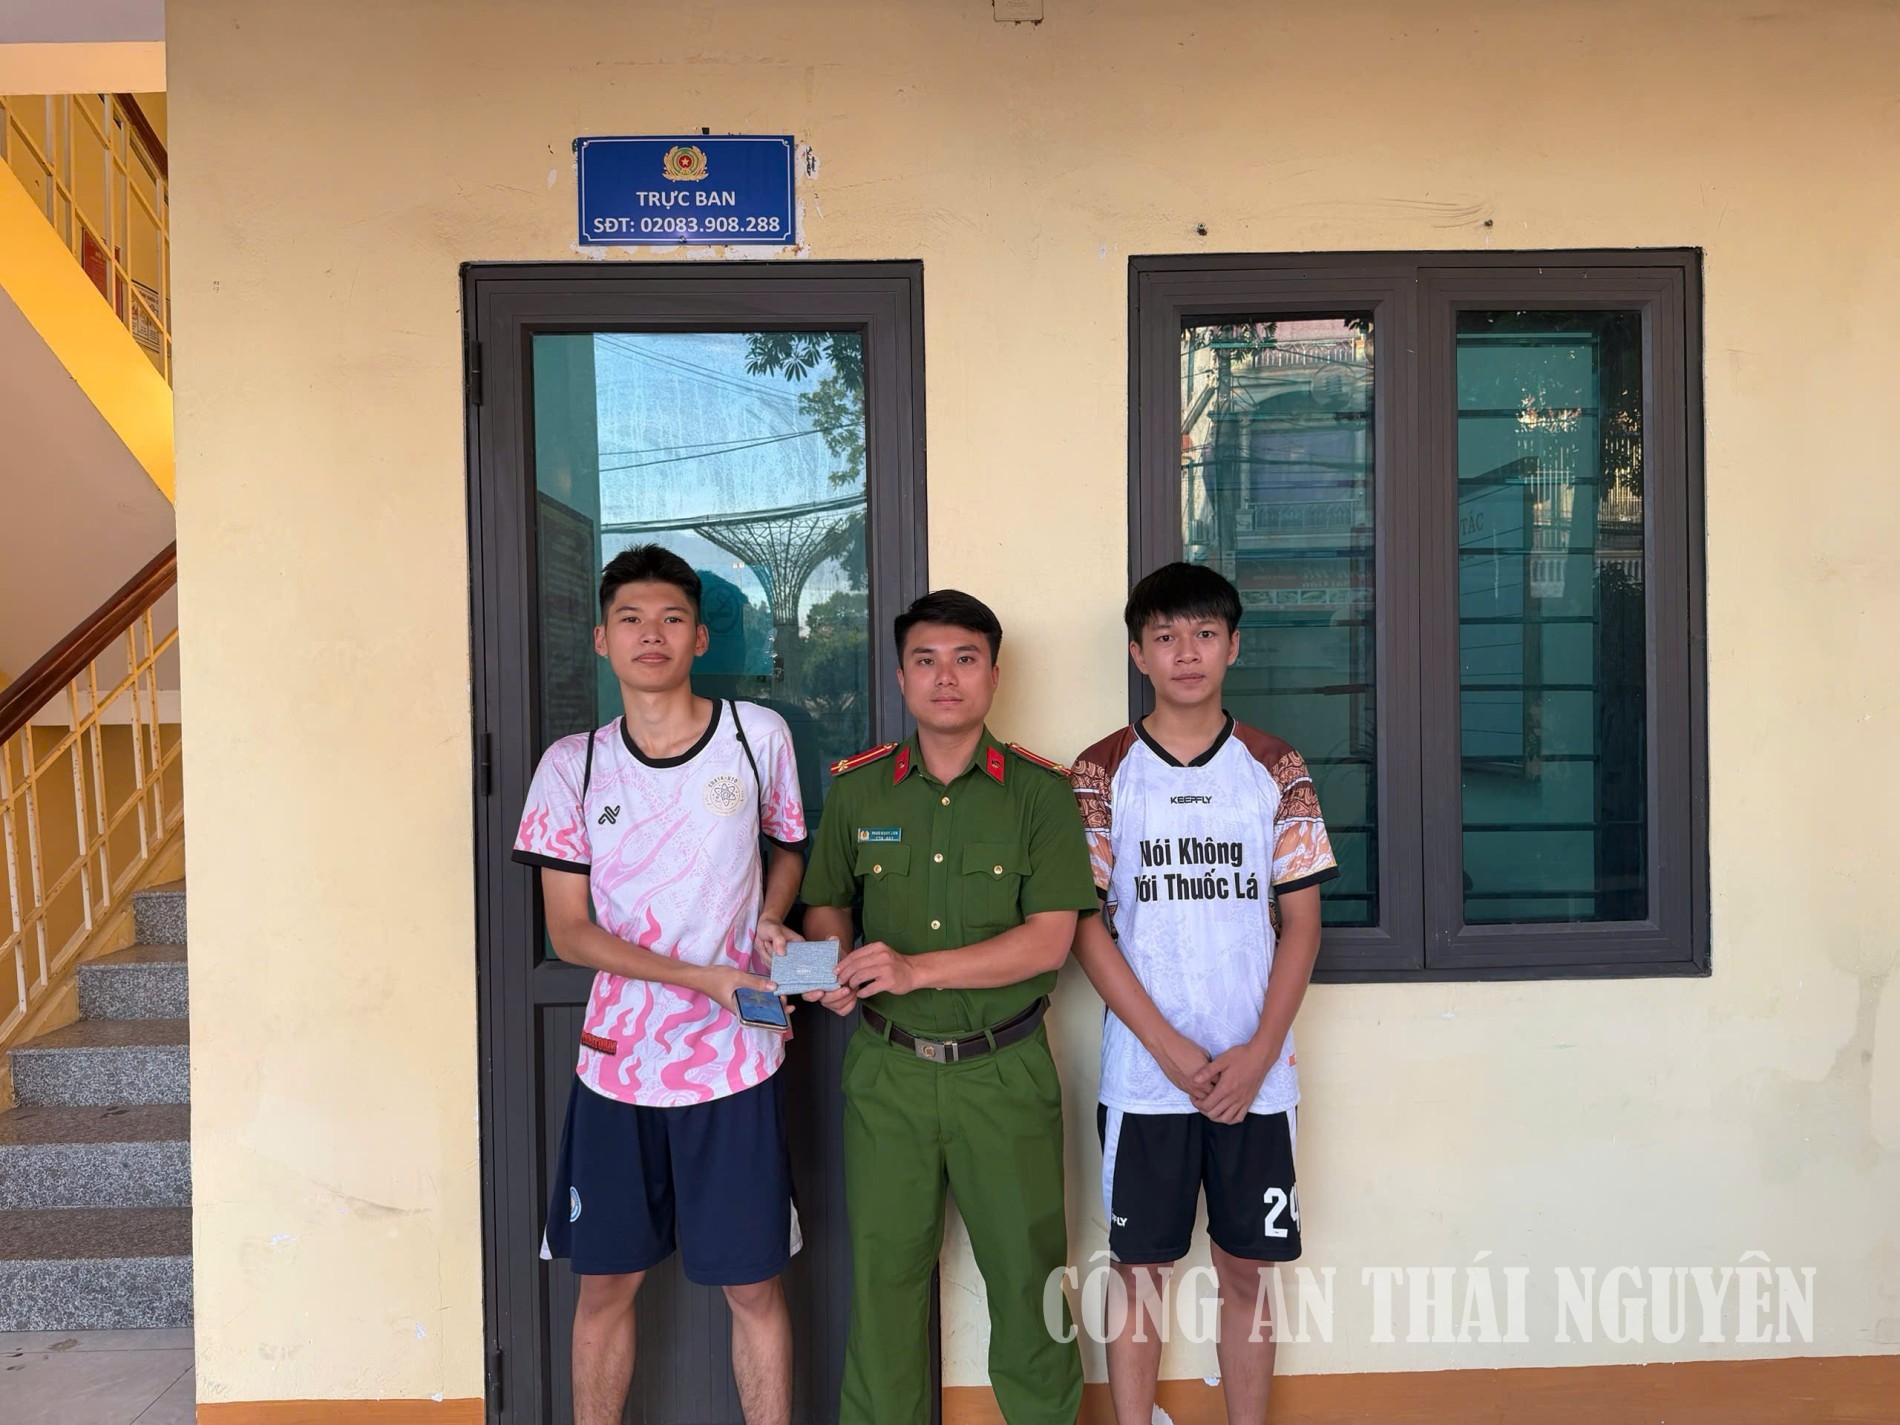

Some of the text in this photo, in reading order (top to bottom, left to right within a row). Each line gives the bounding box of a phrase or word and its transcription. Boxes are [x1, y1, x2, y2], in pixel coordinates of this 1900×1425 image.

[636, 191, 736, 209] TRỰC BAN
[593, 216, 780, 233] SĐT: 02083.908.288
[1140, 836, 1243, 868] Nói Không
[1164, 868, 1229, 901] Thuốc
[1234, 872, 1259, 900] Lá
